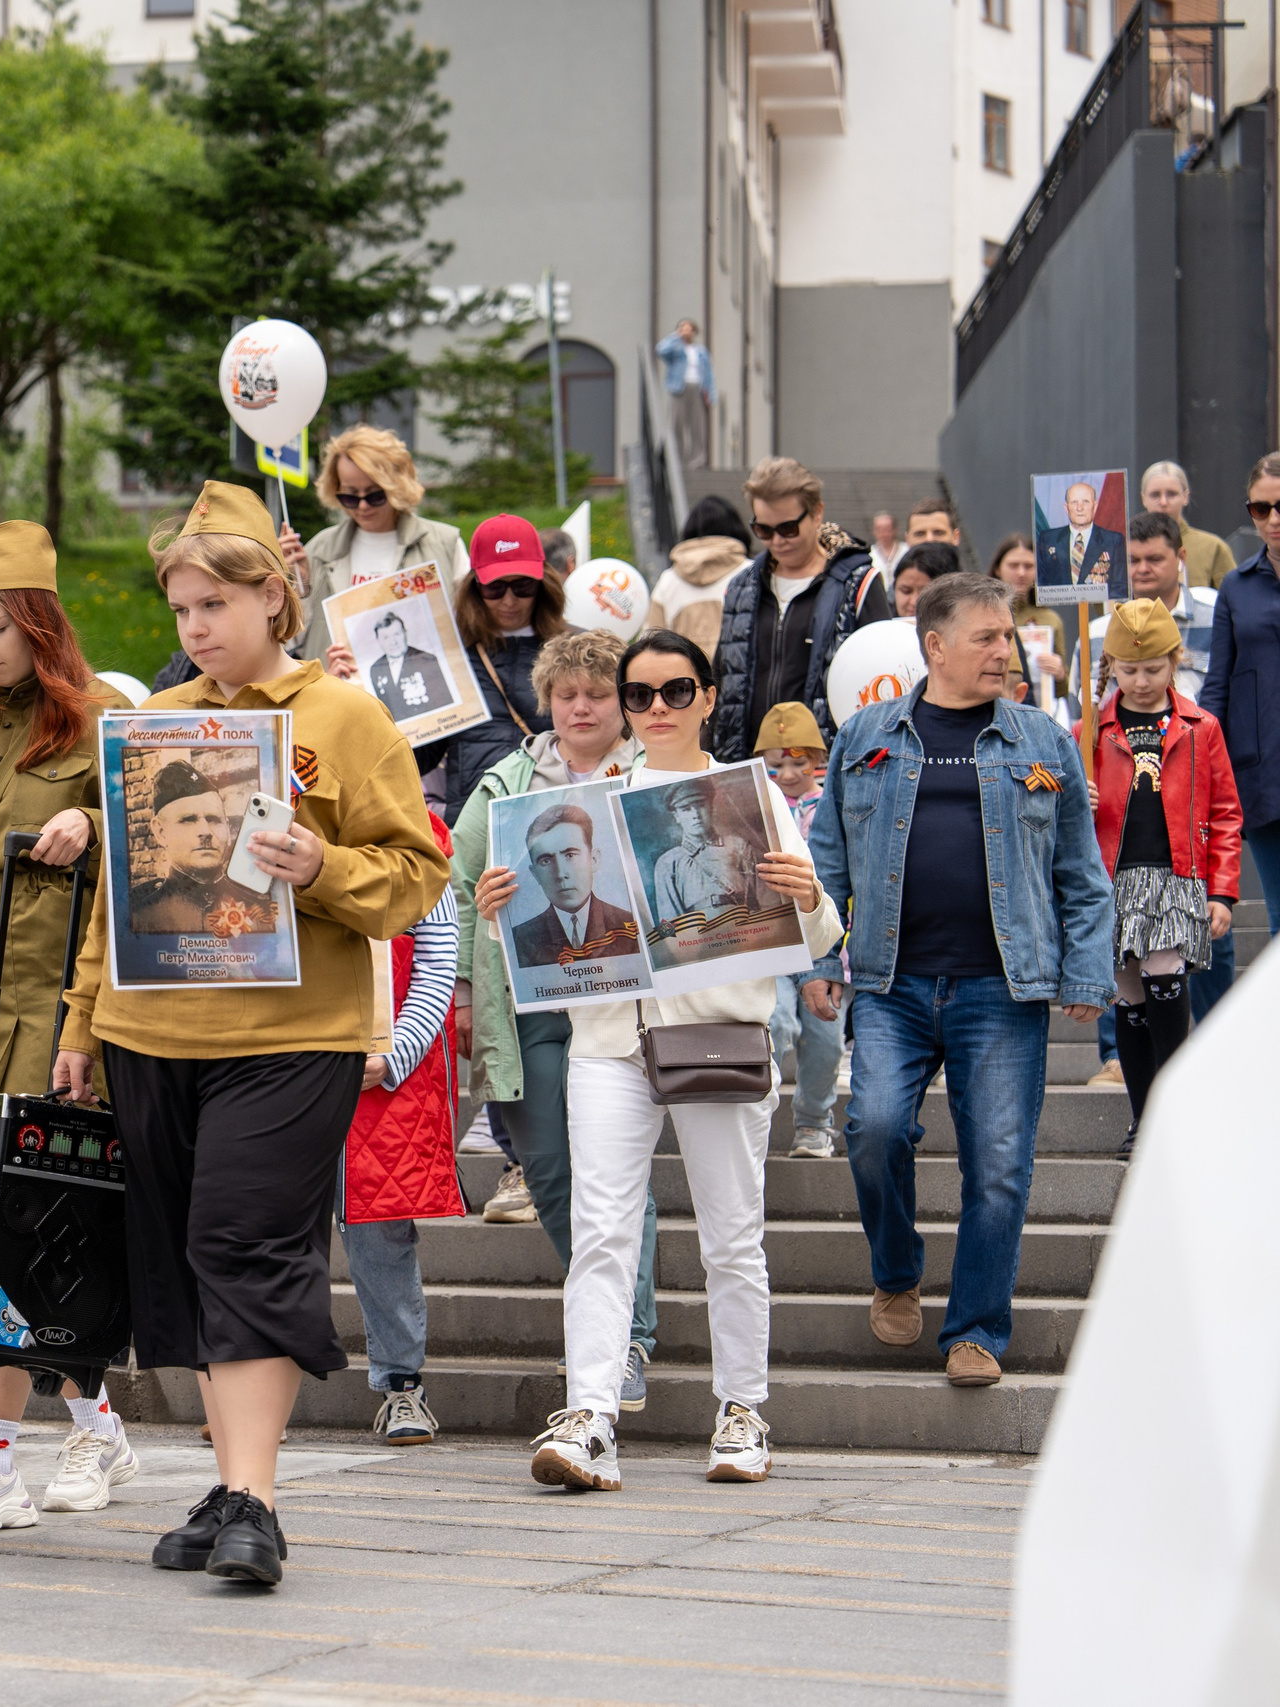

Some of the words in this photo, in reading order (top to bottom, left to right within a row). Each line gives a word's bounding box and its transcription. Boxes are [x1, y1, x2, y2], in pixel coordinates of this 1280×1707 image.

[127, 719, 201, 743] бессмертный
[937, 757, 976, 765] UNSTO
[179, 937, 228, 949] Демидов
[158, 951, 185, 965] Петр
[187, 951, 256, 964] Михайлович
[188, 967, 227, 978] рядовой
[563, 965, 604, 978] Чернов
[535, 982, 582, 998] Николай
[584, 977, 640, 992] Петрович
